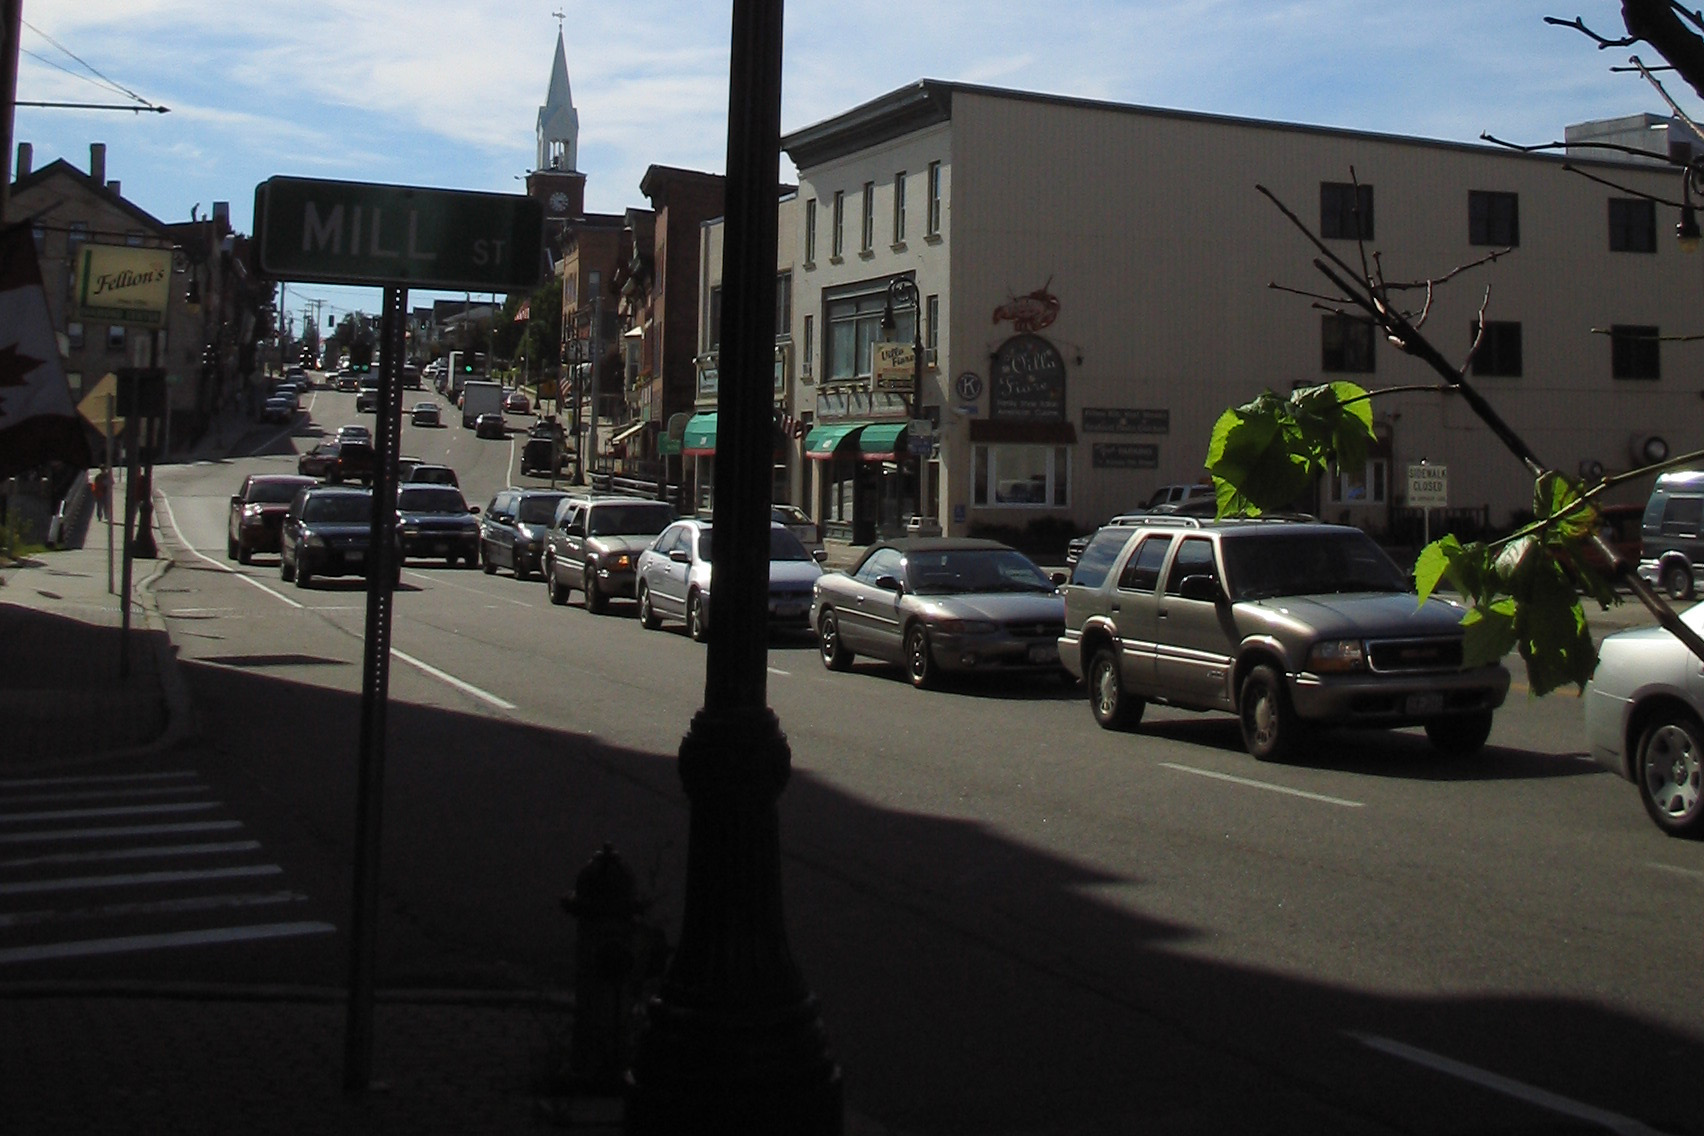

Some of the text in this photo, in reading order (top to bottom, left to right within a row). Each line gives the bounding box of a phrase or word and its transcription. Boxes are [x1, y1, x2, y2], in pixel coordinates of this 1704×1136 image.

[302, 200, 506, 265] MILL ST
[93, 268, 165, 295] Fellion's
[1007, 352, 1056, 374] Villa
[963, 378, 977, 395] K
[1408, 467, 1447, 479] SIDEWALK
[1412, 480, 1443, 492] CLOSED
